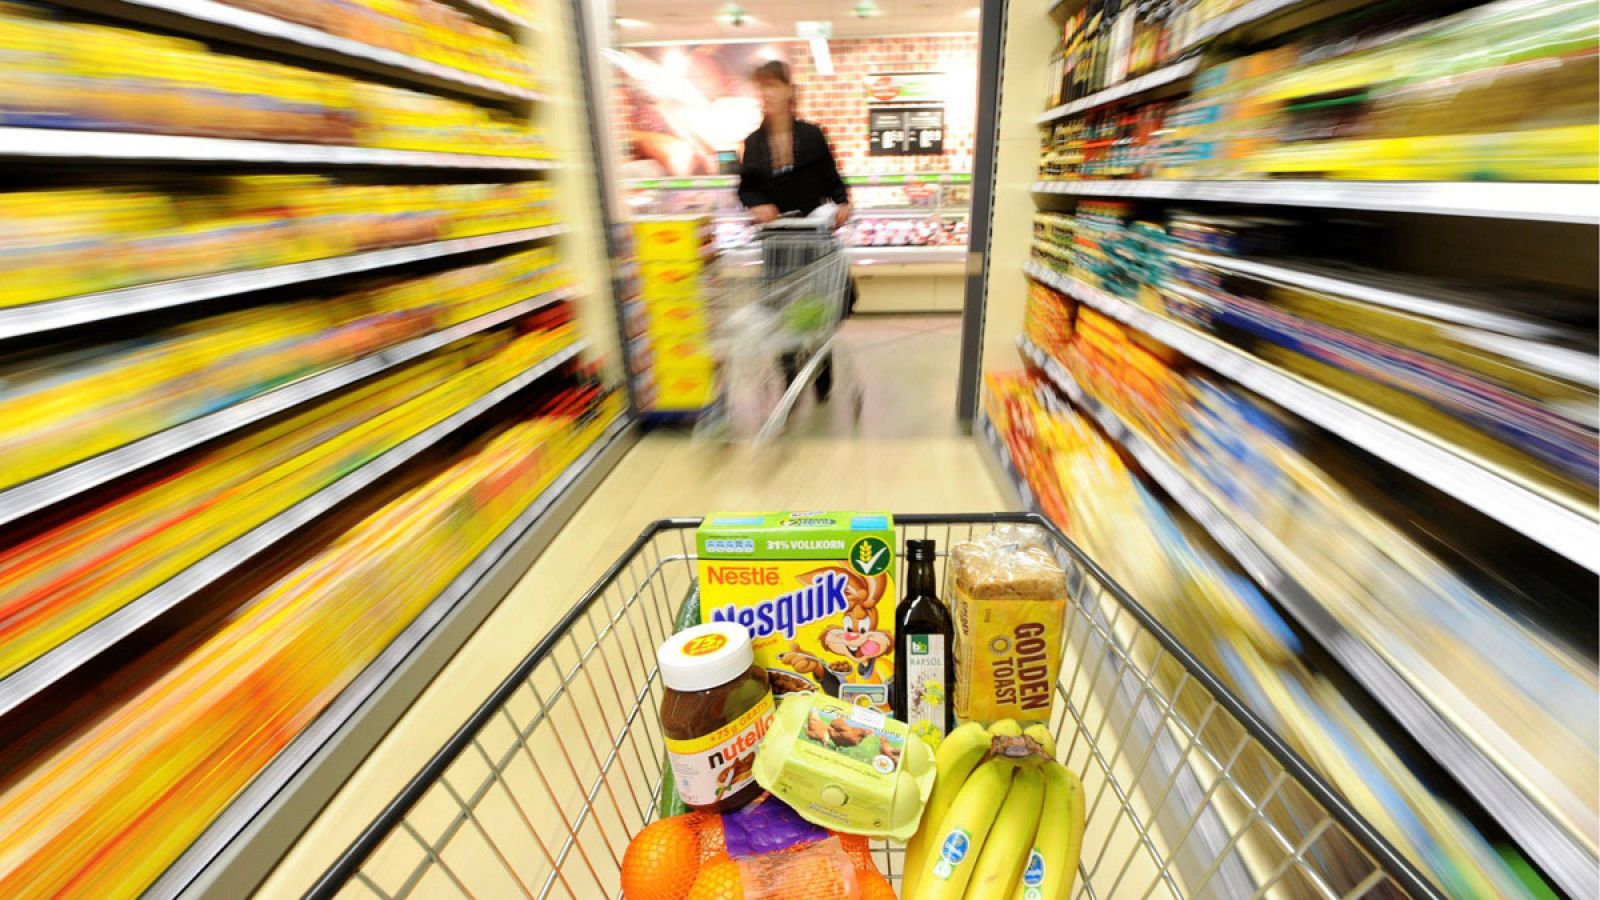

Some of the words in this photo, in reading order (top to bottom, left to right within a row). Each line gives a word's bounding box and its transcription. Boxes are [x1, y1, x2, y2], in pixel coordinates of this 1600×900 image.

[790, 539, 845, 550] VOLLKORN
[991, 657, 1017, 704] TOAST
[1014, 622, 1050, 710] GOLDEN
